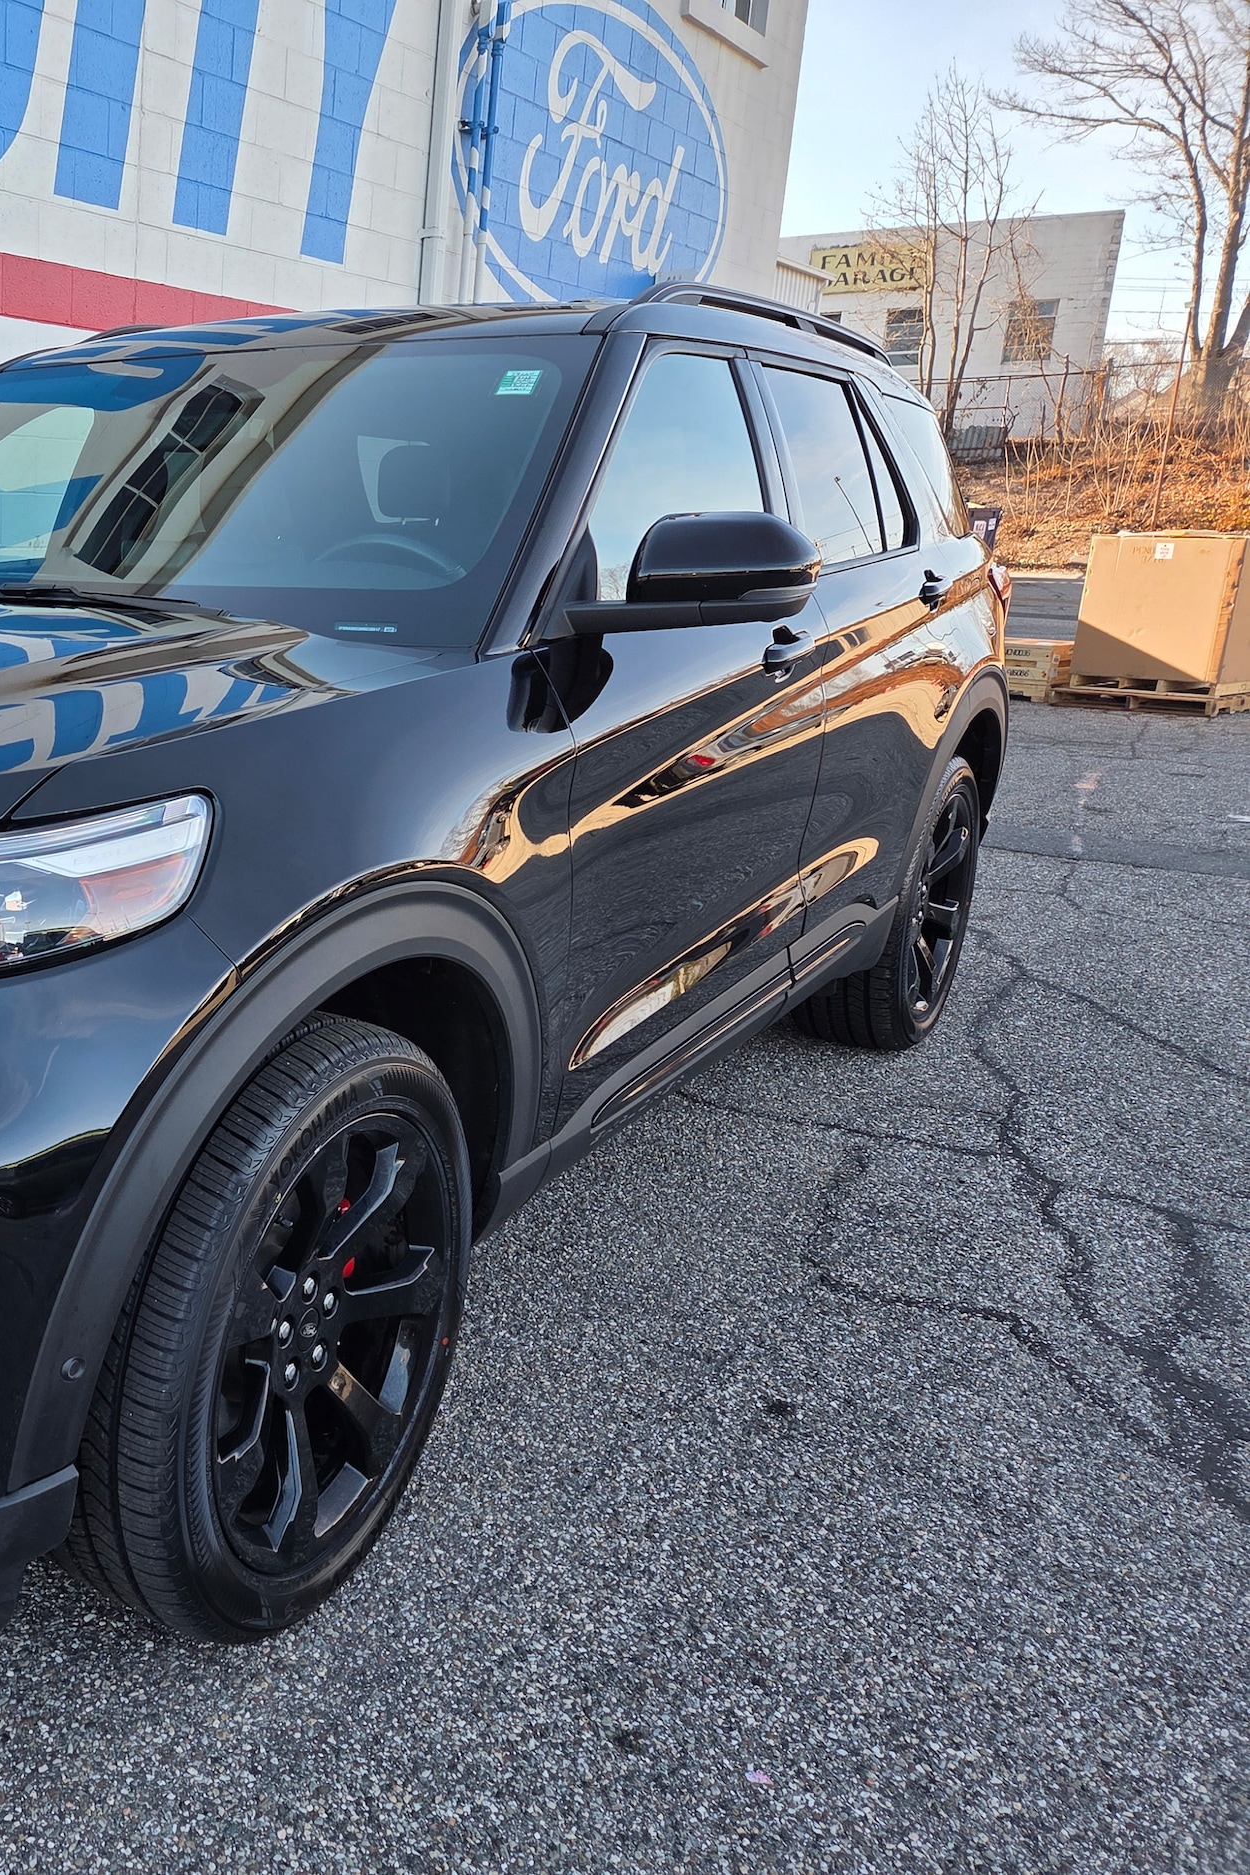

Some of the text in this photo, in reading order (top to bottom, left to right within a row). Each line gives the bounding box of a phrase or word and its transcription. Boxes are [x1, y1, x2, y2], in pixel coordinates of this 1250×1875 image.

[519, 30, 685, 276] Ford
[821, 249, 919, 269] FAMI
[827, 266, 920, 287] ARAG
[72, 832, 181, 867] EXPLER
[269, 1083, 358, 1188] YOKOHAMA
